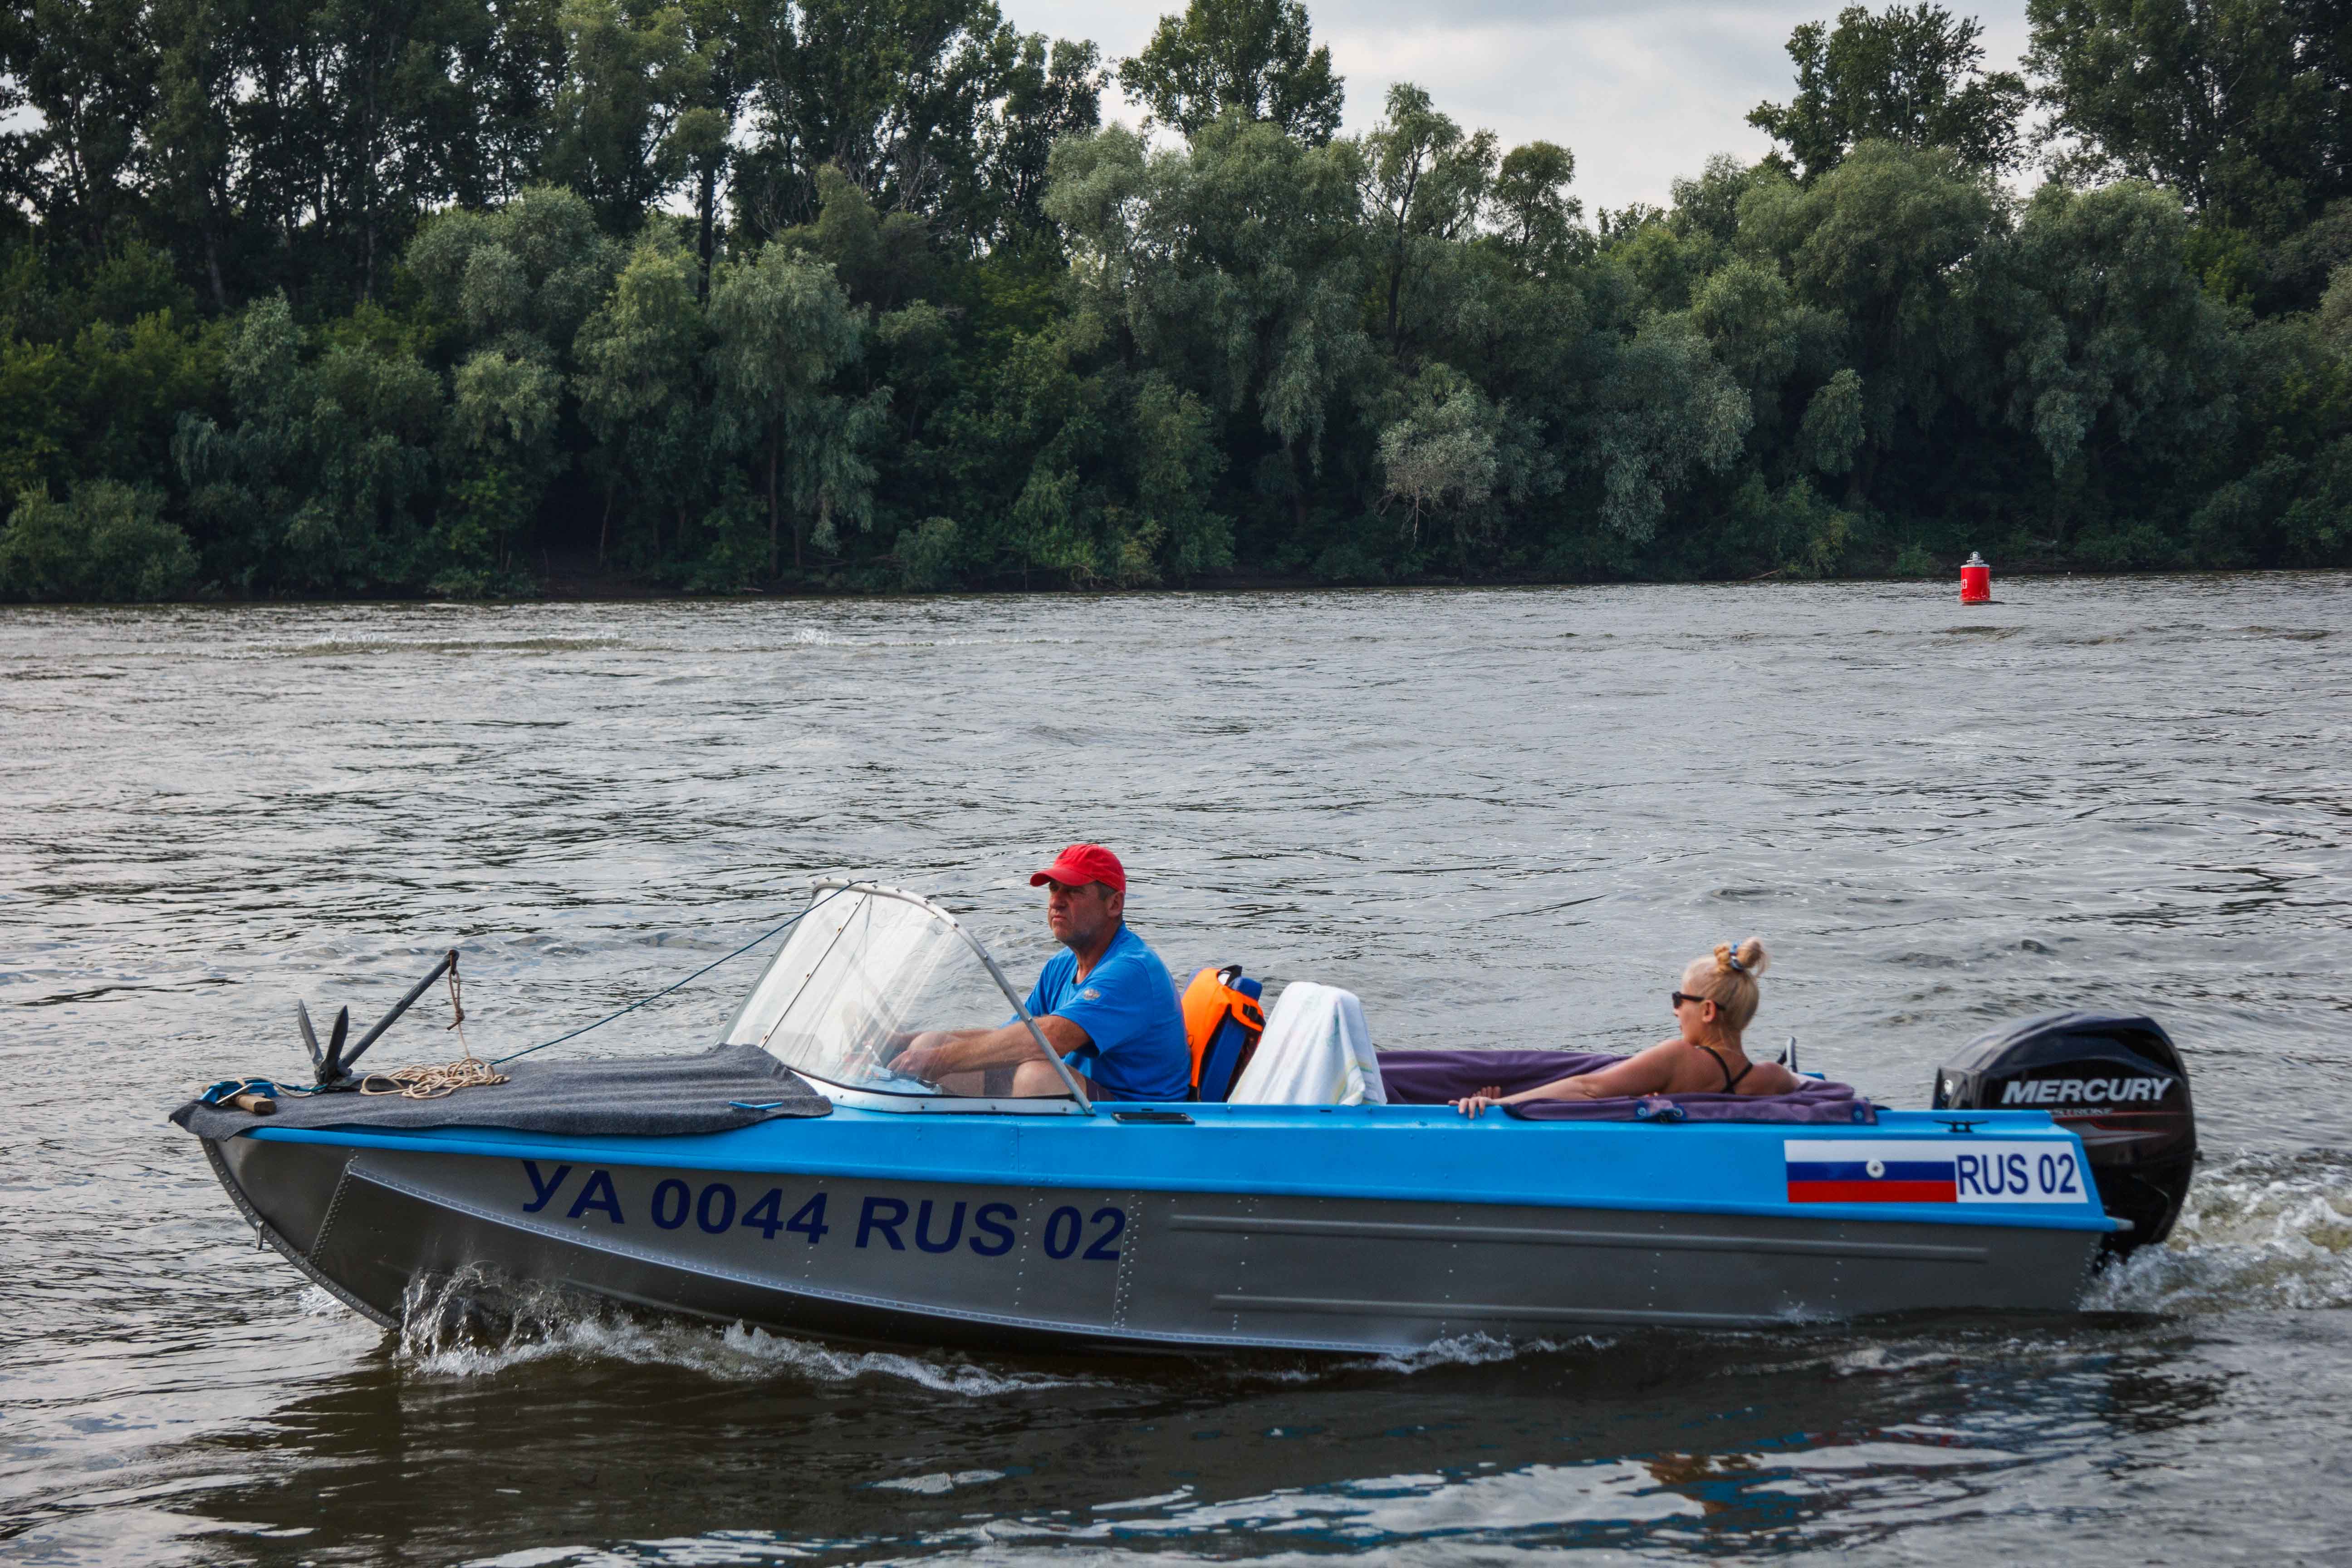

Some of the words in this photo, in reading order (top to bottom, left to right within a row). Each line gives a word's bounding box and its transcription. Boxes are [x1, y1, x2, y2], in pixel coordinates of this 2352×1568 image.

[2002, 1078, 2172, 1103] MERCURY
[1957, 1154, 2029, 1195] RUS
[2038, 1153, 2077, 1194] 02
[652, 1178, 828, 1245] 0044
[855, 1197, 1018, 1256] RUS
[1044, 1206, 1126, 1260] 02
